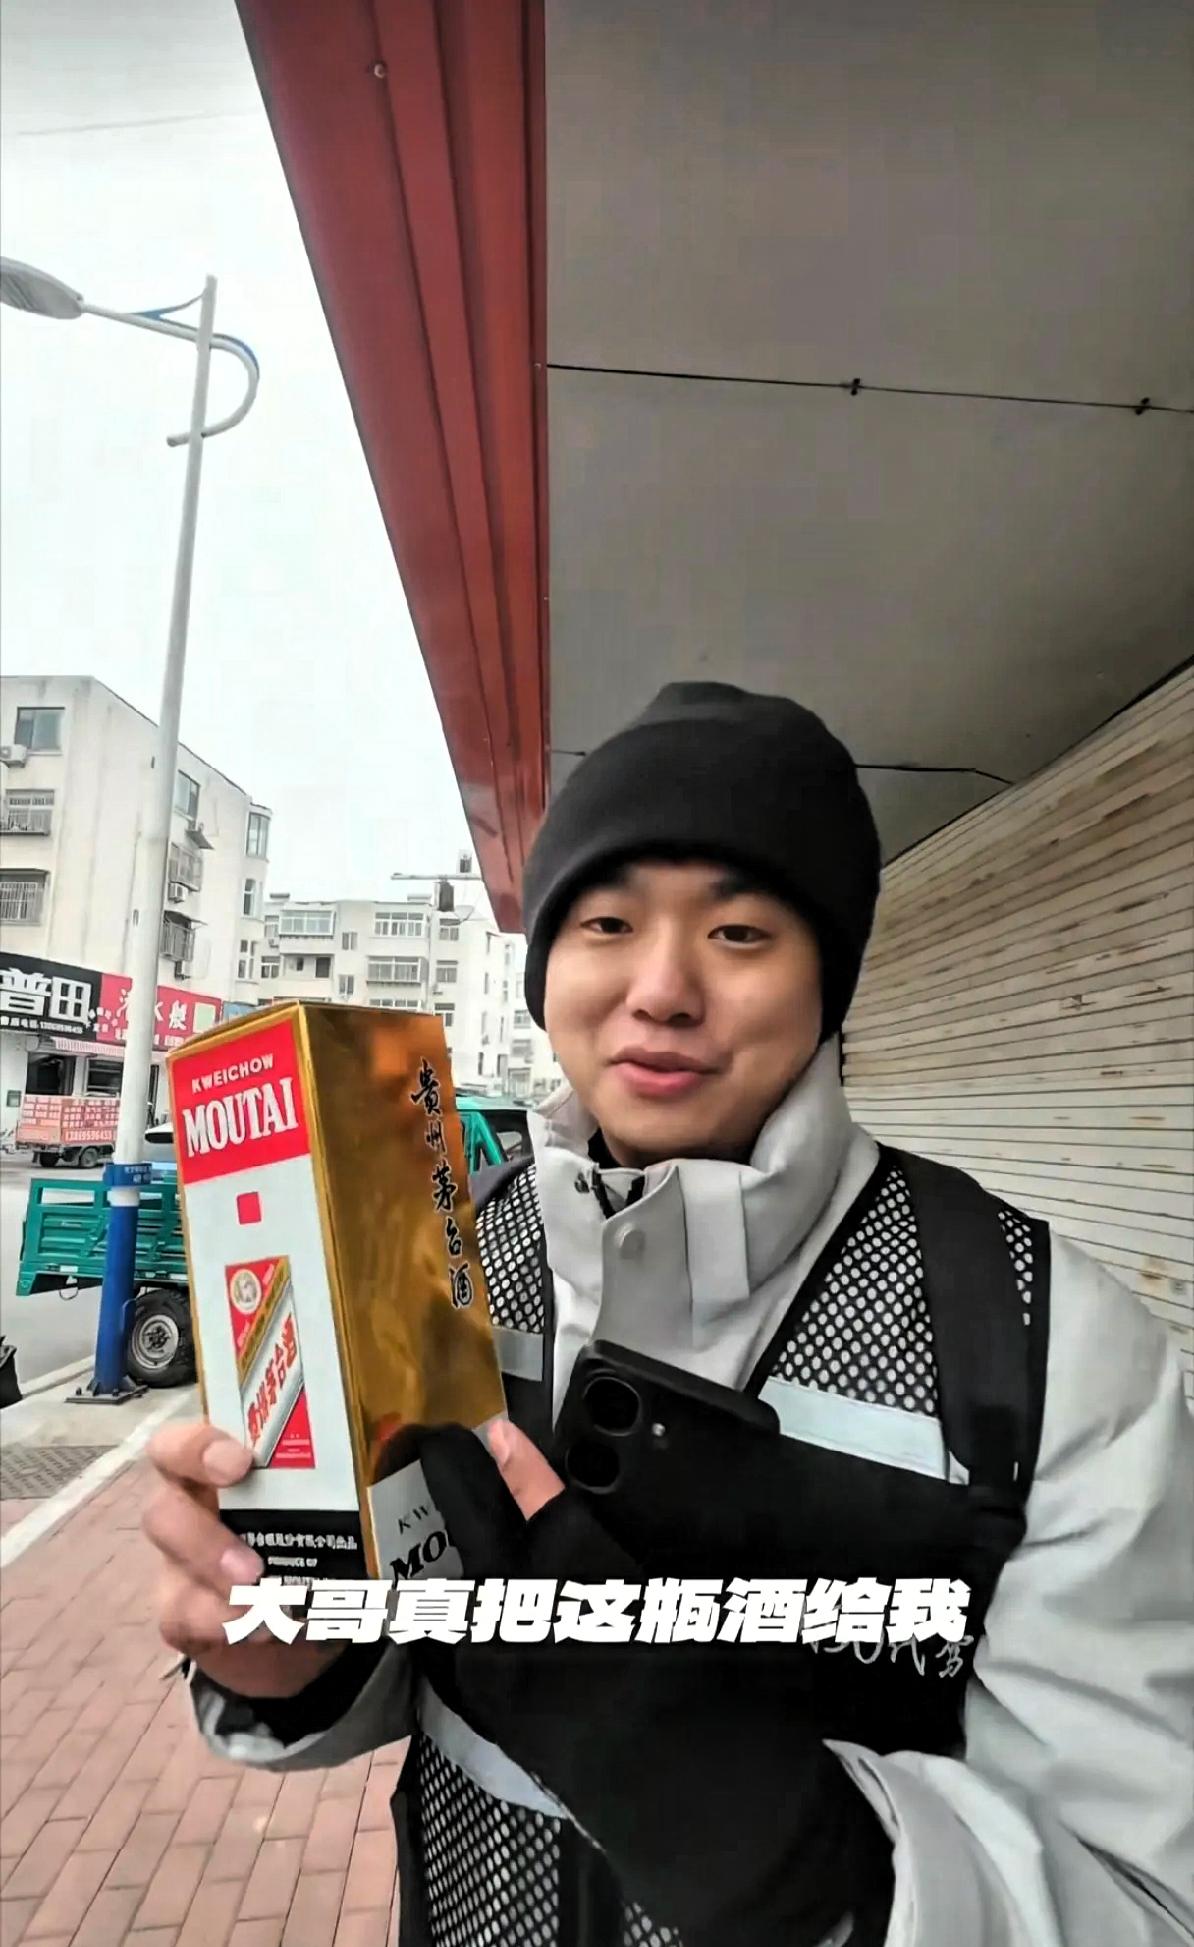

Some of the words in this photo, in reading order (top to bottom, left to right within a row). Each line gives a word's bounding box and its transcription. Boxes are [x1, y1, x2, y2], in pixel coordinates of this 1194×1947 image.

[0, 967, 92, 1023] 普田
[191, 1053, 274, 1094] KWEICHOW
[183, 1077, 299, 1158] MOUTAI
